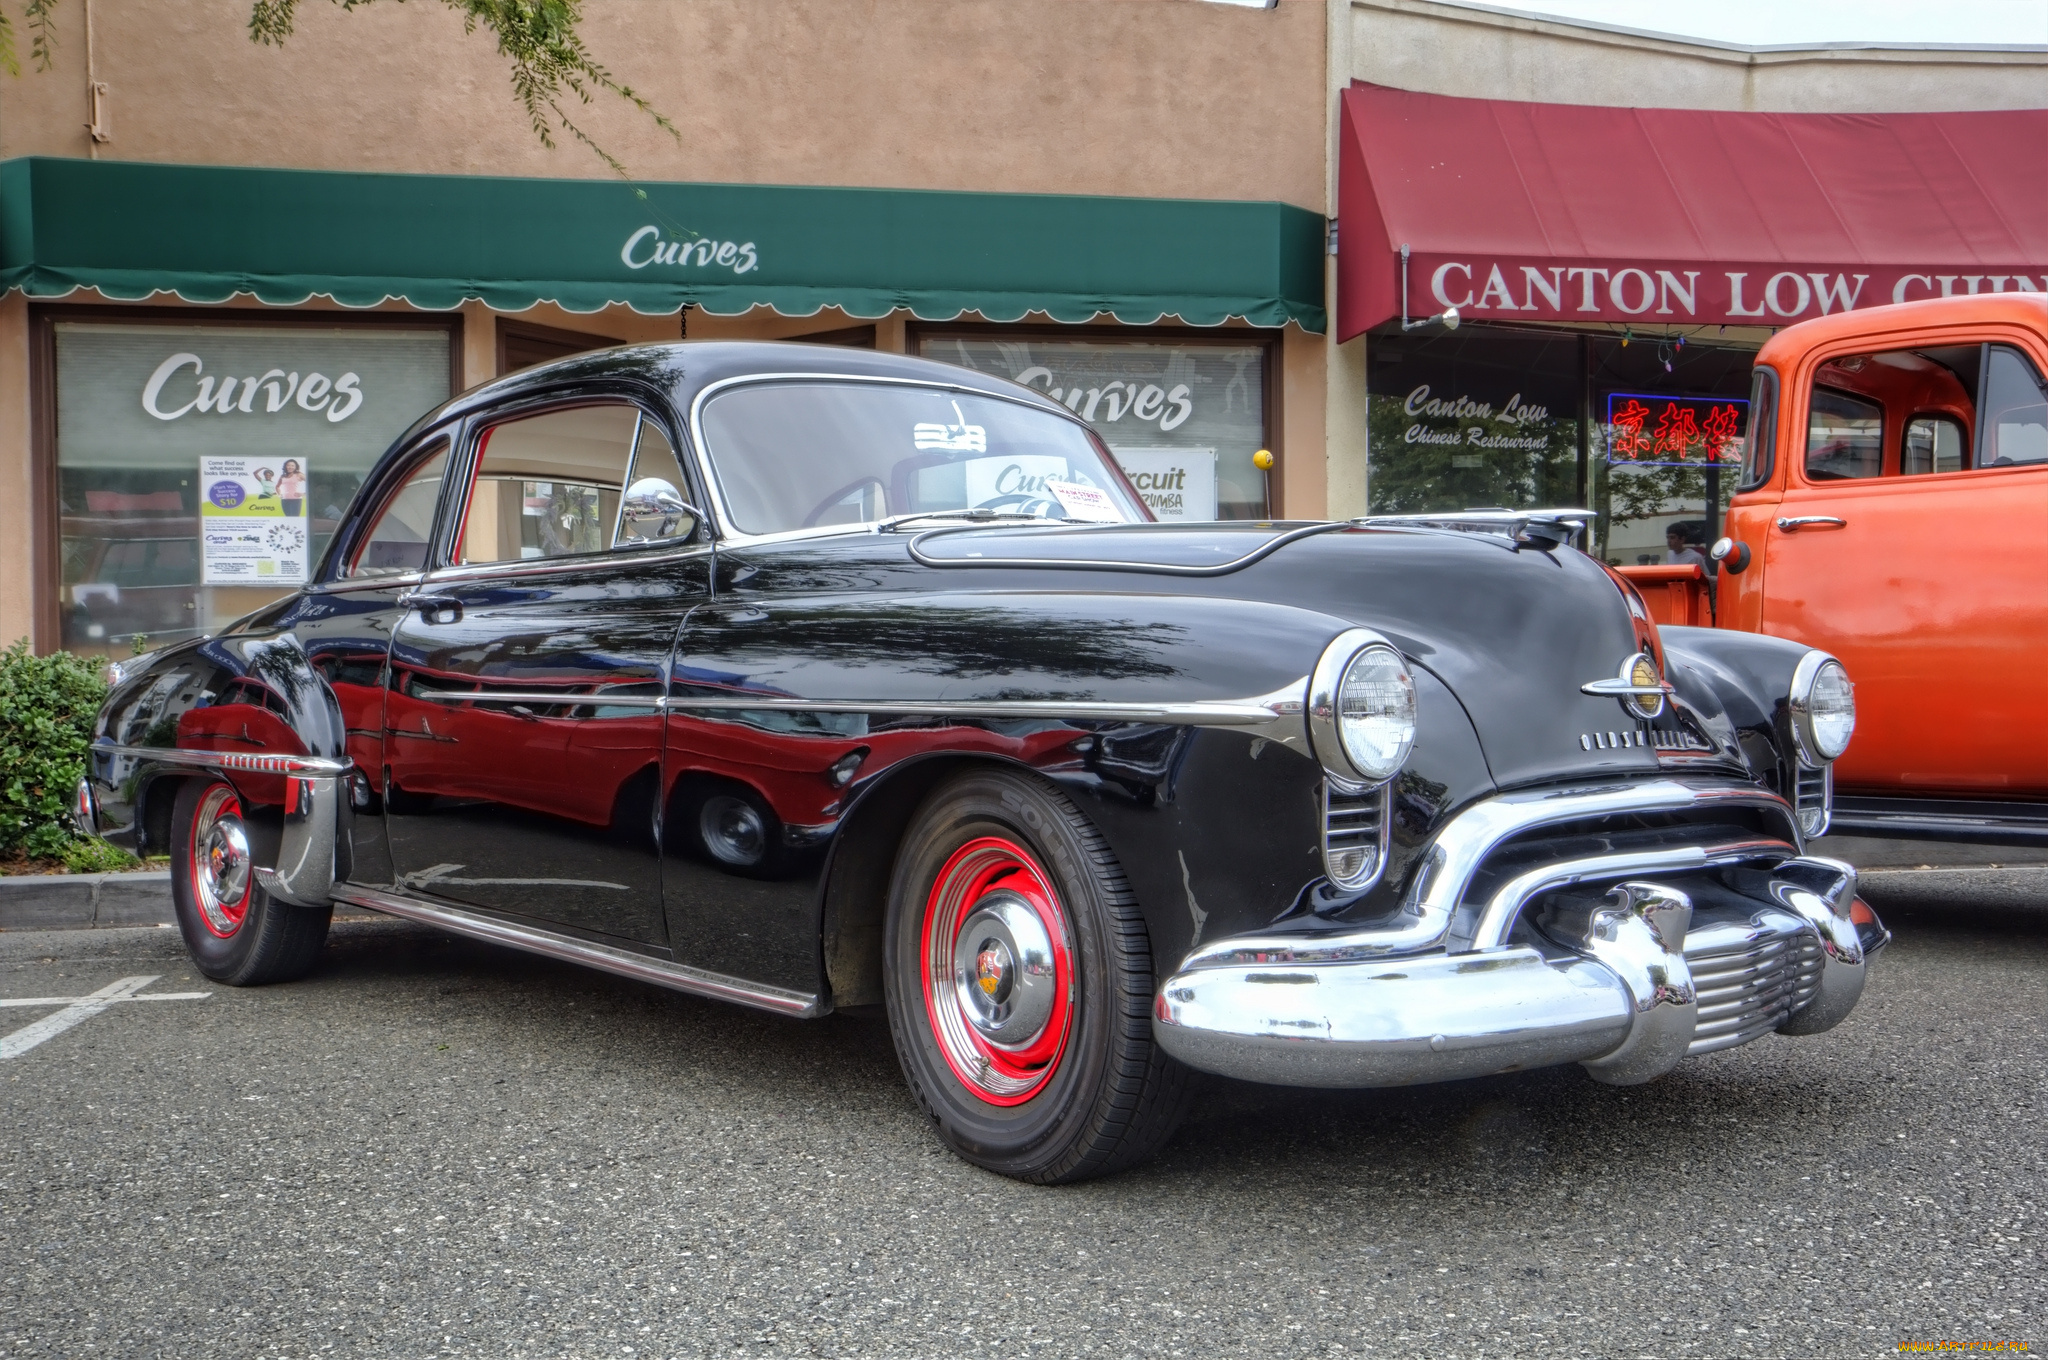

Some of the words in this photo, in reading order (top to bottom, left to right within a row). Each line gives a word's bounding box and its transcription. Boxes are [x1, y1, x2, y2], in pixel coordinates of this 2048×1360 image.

[621, 225, 757, 274] Curves
[1431, 262, 1700, 315] CANTON
[1725, 272, 1870, 317] LOW
[142, 353, 363, 422] Curves
[1404, 384, 1492, 419] Canton
[1495, 393, 1549, 424] Low
[1405, 424, 1462, 445] Chinese
[1467, 427, 1549, 449] Restaurant
